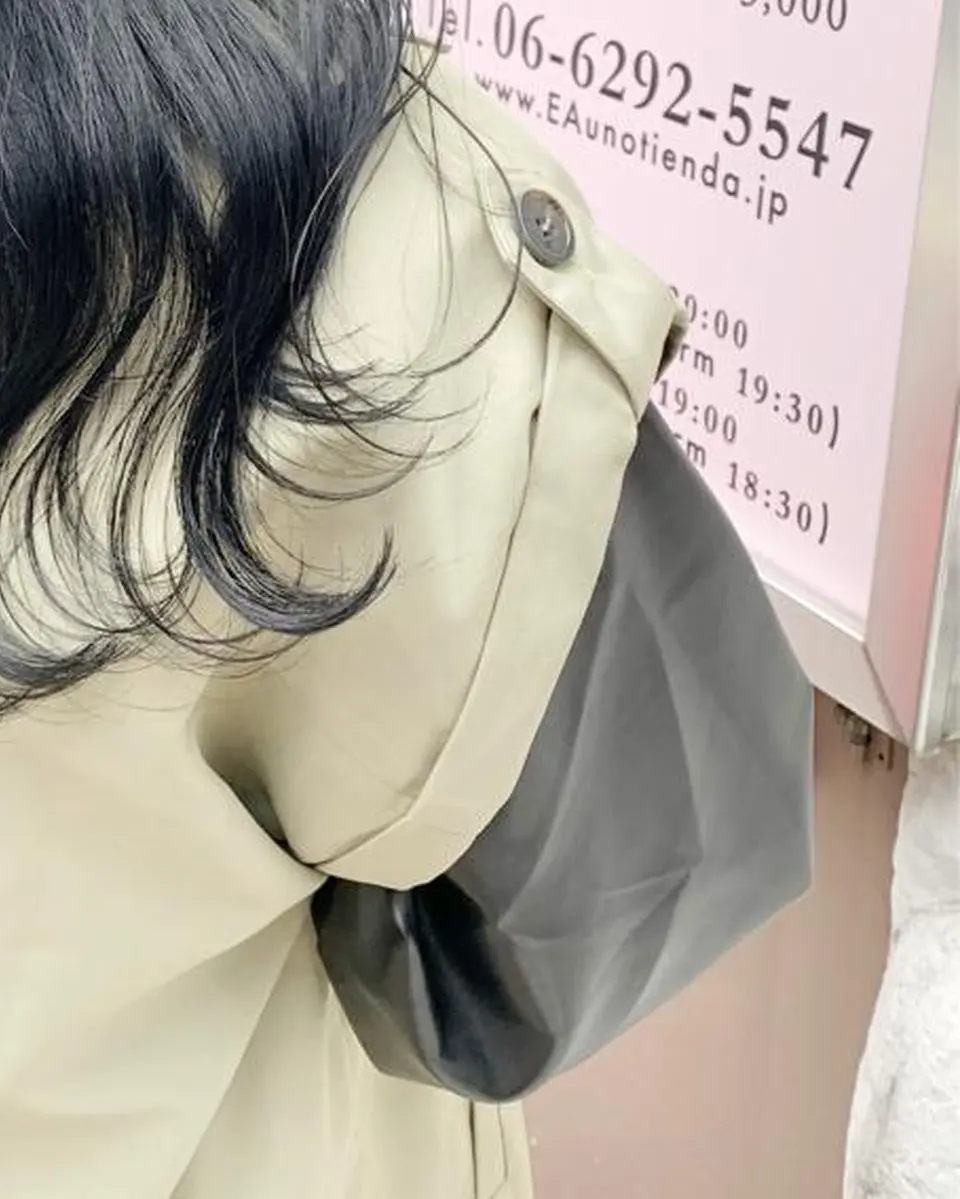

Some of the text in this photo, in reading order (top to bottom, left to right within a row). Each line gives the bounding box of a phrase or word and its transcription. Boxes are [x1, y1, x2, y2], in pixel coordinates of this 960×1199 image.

[670, 285, 748, 350] 0:00
[658, 379, 737, 444] 19:00
[737, 366, 839, 449] 19:30)
[727, 461, 828, 544] 18:30)
